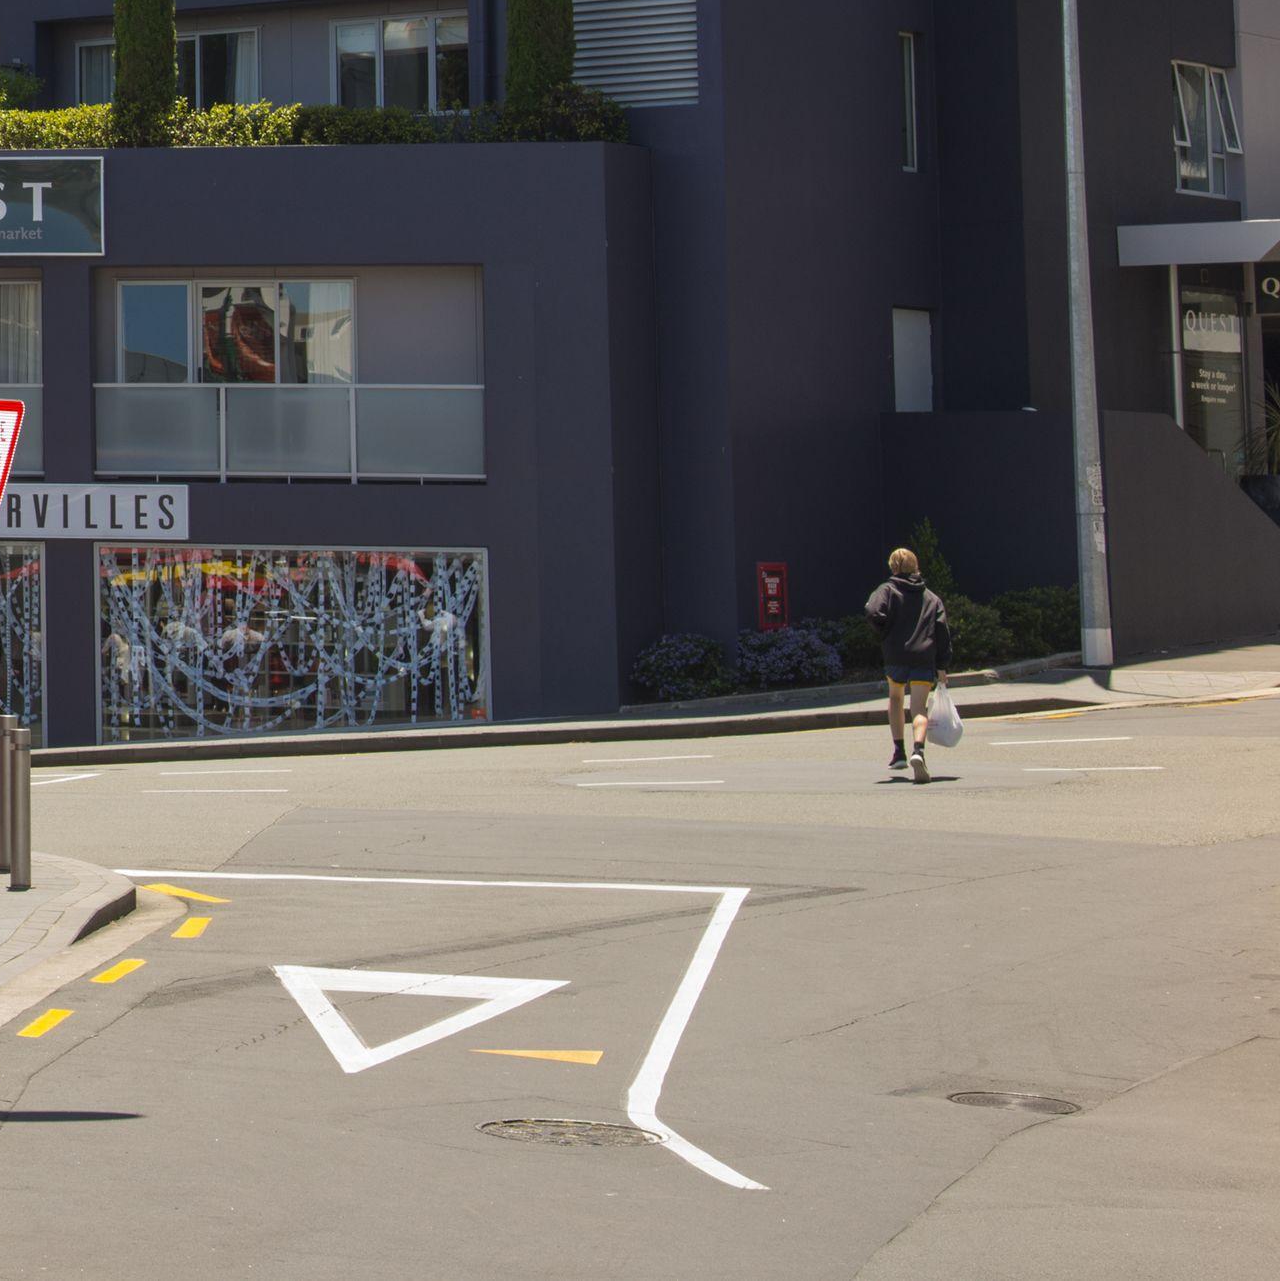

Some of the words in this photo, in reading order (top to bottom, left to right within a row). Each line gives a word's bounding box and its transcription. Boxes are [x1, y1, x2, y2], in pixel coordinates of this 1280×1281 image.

[1185, 309, 1237, 335] QUEST
[1198, 368, 1211, 380] Stay
[1196, 381, 1210, 390] week
